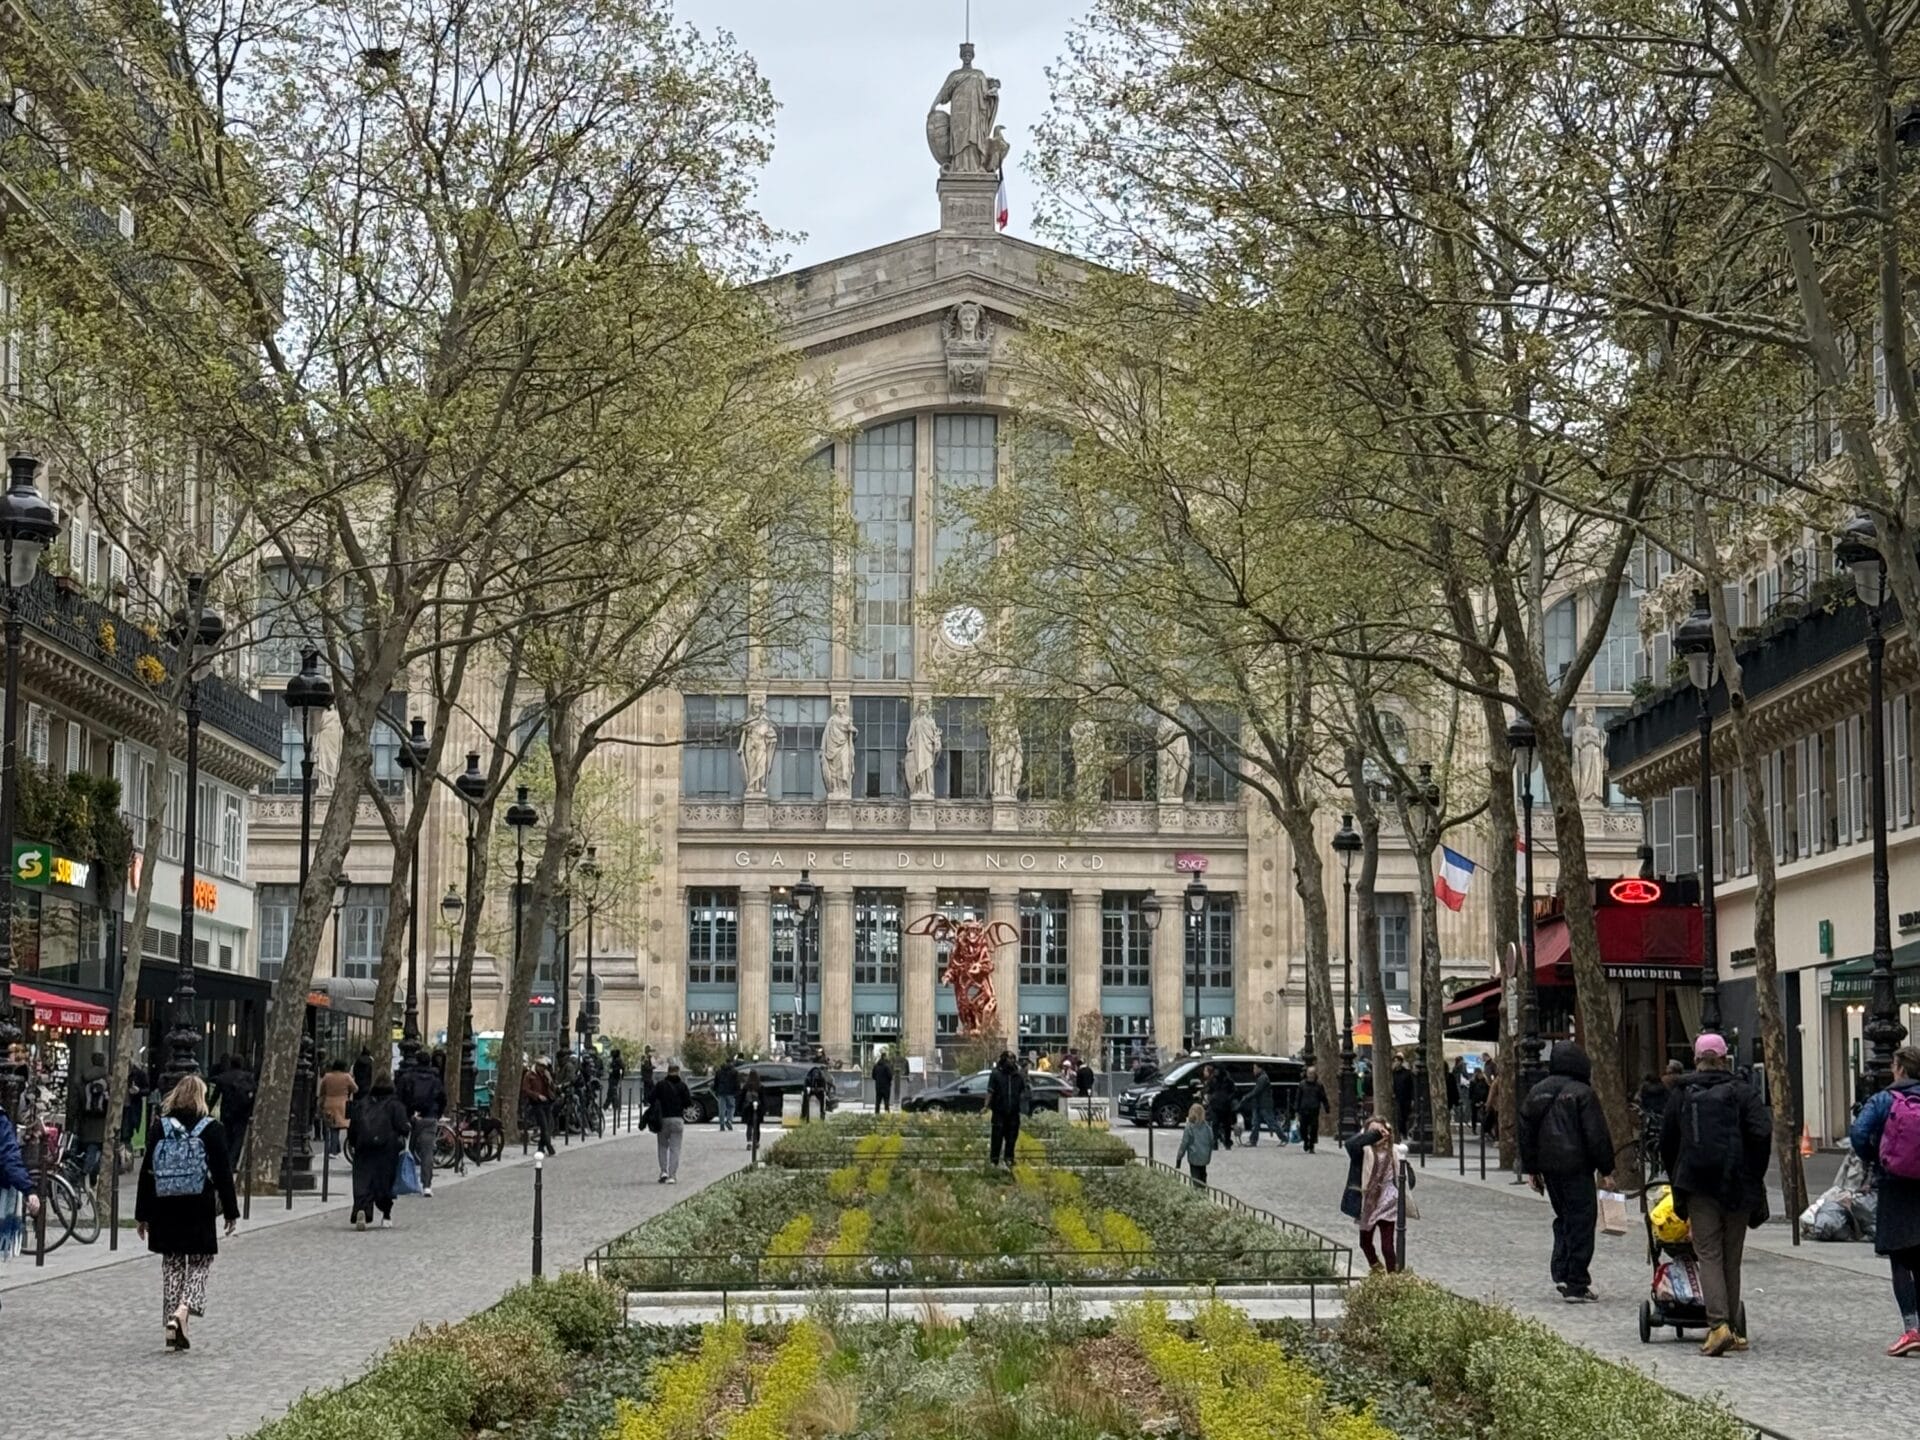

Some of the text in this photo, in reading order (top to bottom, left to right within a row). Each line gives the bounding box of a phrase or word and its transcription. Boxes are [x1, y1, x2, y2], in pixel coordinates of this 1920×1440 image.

[735, 851, 1104, 870] GARE DU NORD
[1176, 858, 1207, 870] SNCF
[1608, 968, 1682, 980] BAROUDEUR
